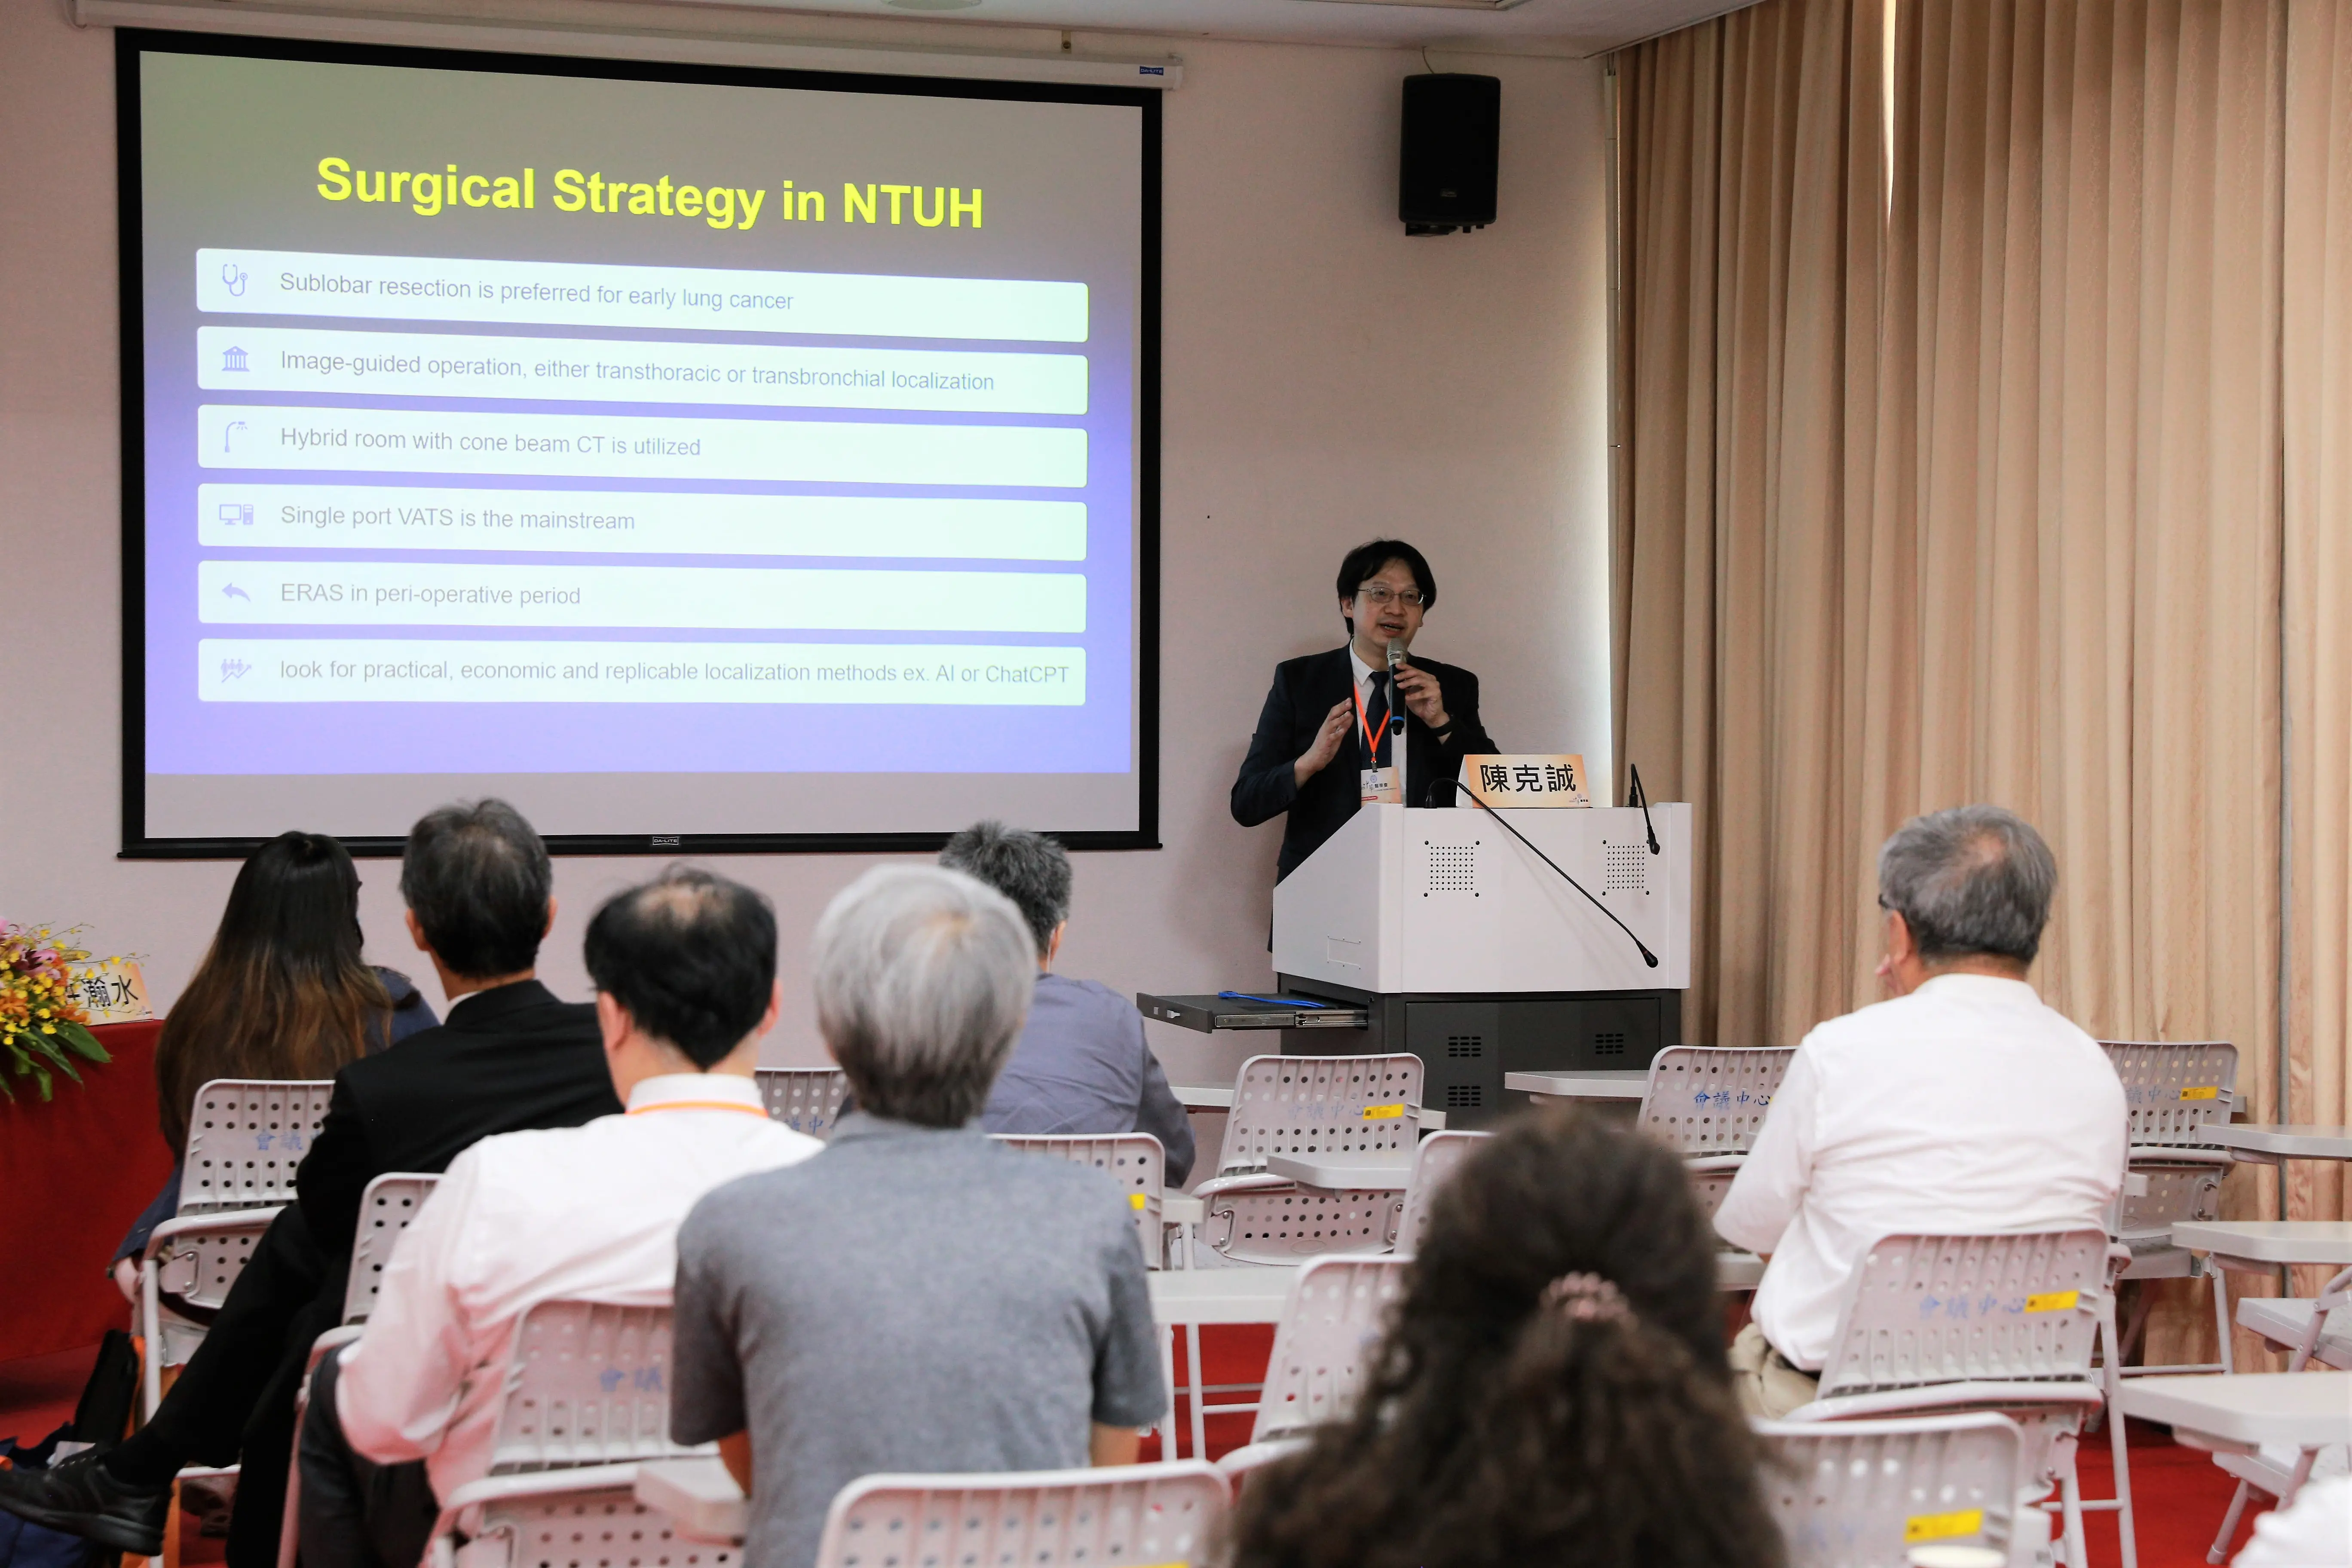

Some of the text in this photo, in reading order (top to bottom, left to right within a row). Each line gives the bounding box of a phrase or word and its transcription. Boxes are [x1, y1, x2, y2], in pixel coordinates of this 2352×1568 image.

[318, 157, 983, 230] Surgical Strategy in NTUH
[281, 273, 793, 312] Sublobar resection is preferred for early lung cancer
[282, 351, 994, 390] Image-guided operation, either transthoracic or transbronchial localization
[282, 428, 700, 455] Hybrid room with cone beam CT is utilized
[282, 506, 634, 529] Single port VATS is the mainstream
[282, 584, 580, 608] ERAS in peri-operative period
[281, 661, 1069, 683] look for practical, economic and replicable localization methods ex. AI or ChatCPT
[1480, 764, 1577, 793] 陳克誠
[1694, 1090, 1770, 1111] 會議中心
